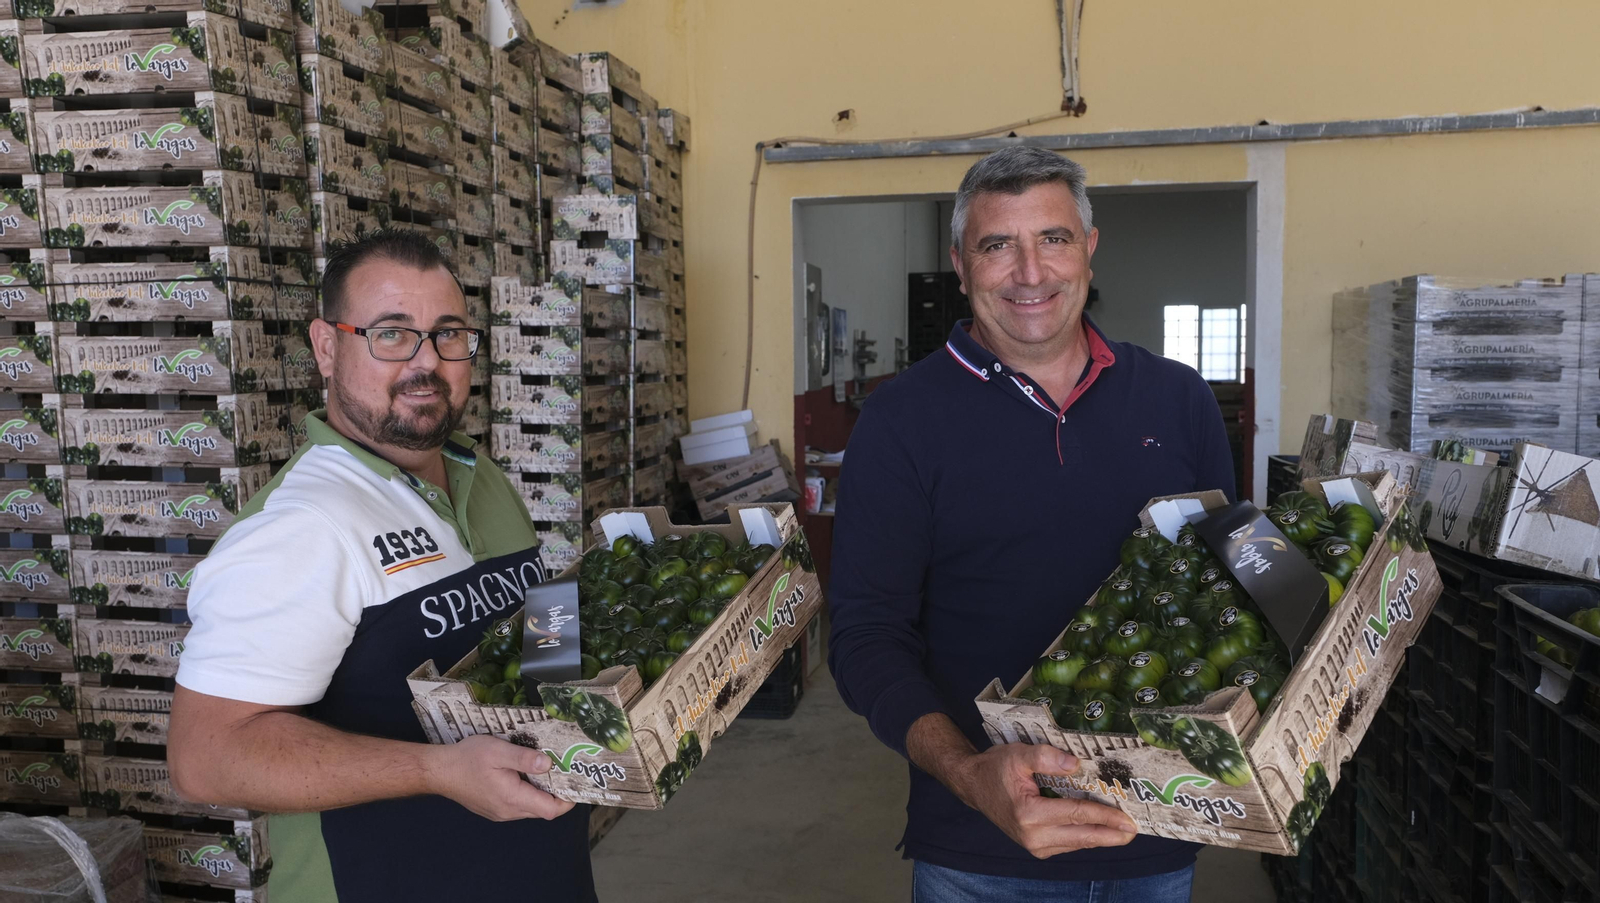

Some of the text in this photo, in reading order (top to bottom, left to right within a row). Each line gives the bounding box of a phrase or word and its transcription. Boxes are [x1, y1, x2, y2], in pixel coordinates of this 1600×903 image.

[1458, 297, 1537, 307] AGRUPALMERÍA
[1456, 344, 1535, 354] AGRUPALMERÍA
[1455, 391, 1533, 400] AGRUPALMERÍA
[372, 526, 439, 567] 1933
